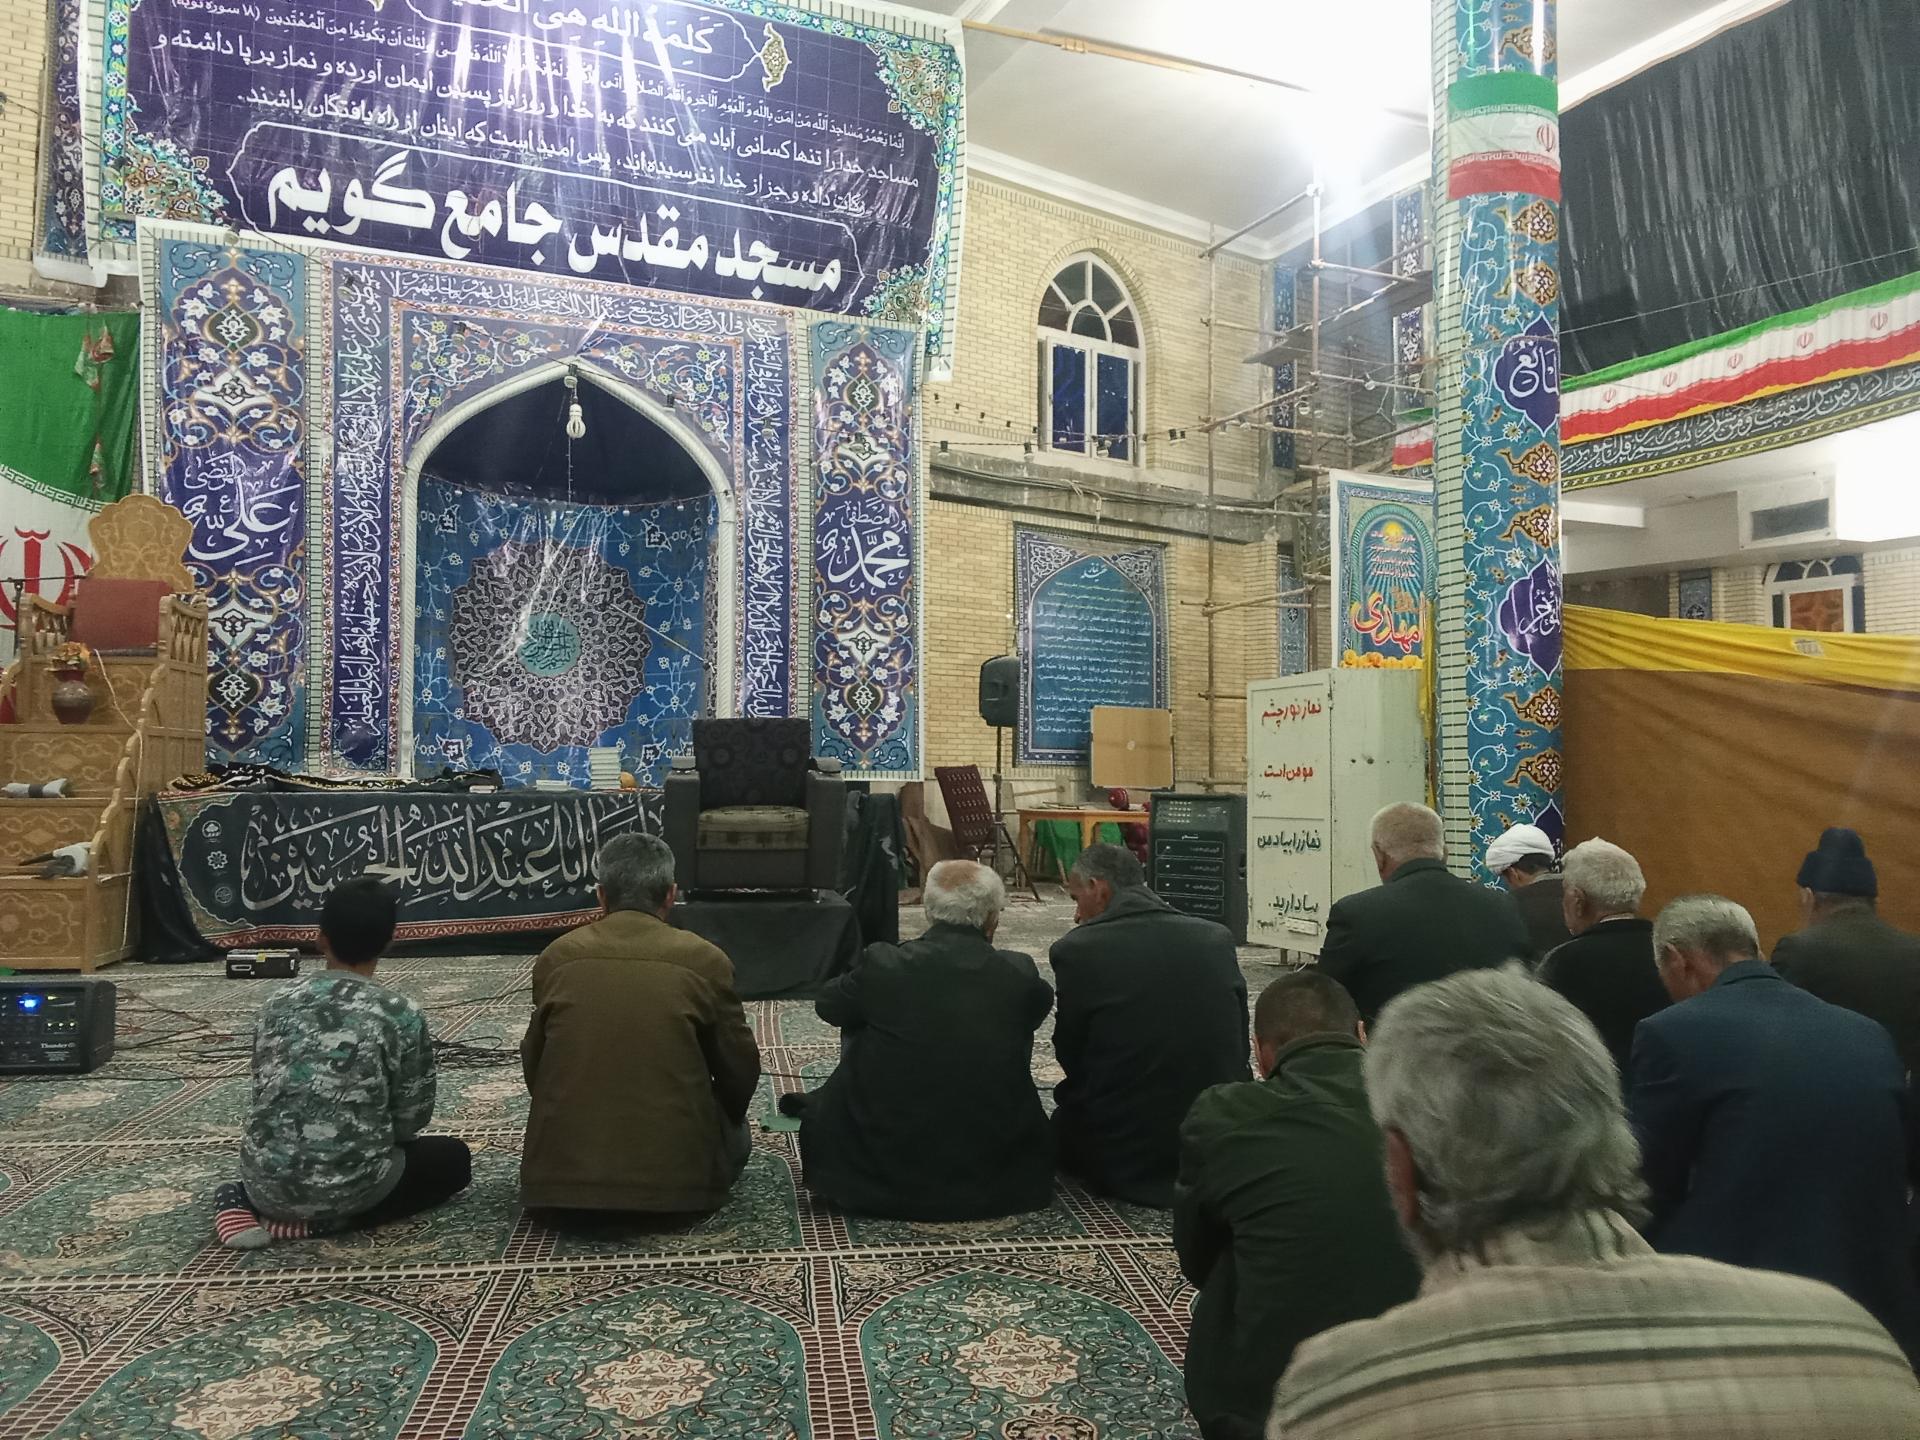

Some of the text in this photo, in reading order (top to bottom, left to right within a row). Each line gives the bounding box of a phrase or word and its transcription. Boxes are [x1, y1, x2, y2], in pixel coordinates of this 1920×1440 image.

[268, 149, 842, 300] مسجد مقدس جامع گویم
[828, 526, 910, 590] محمد
